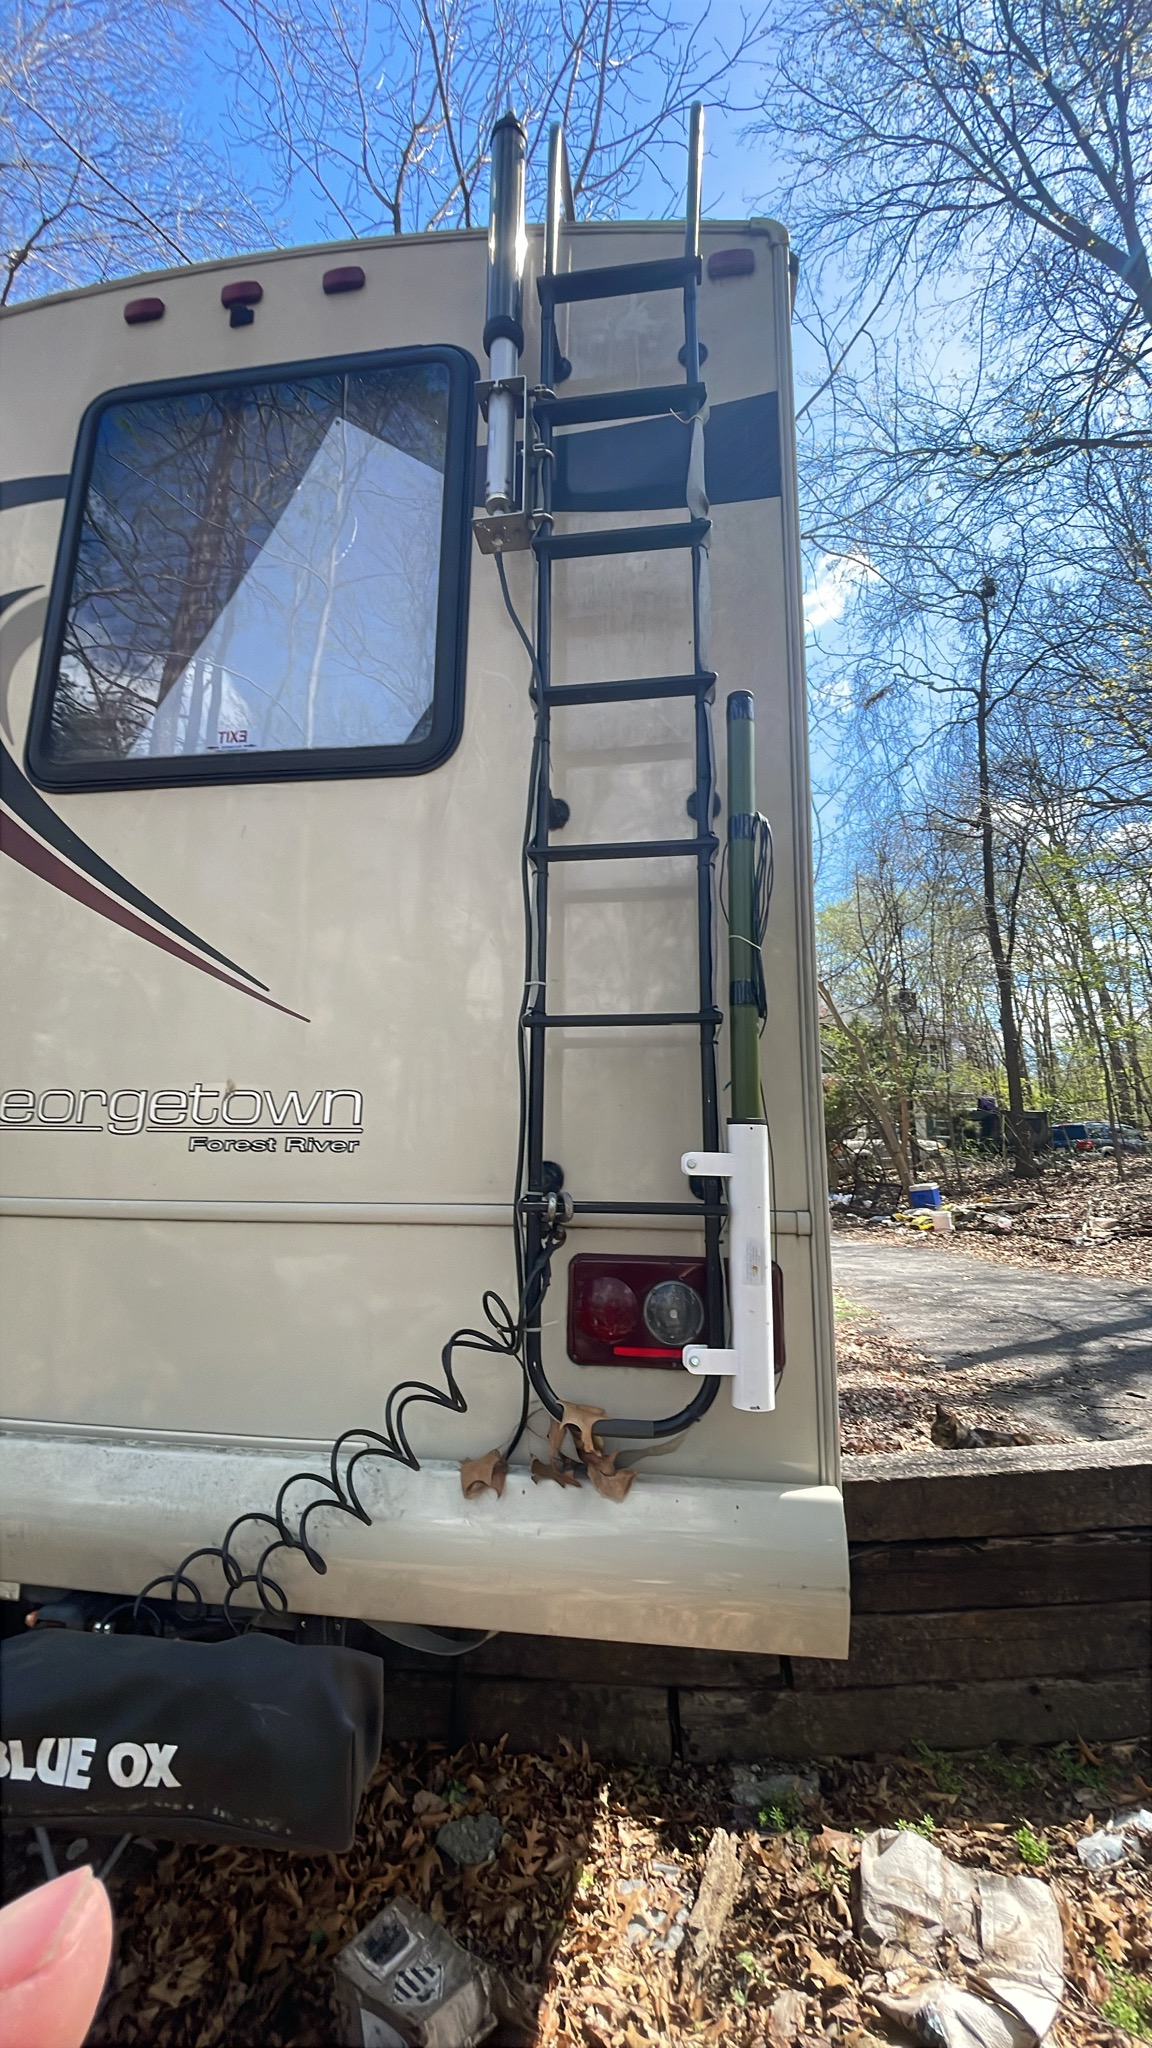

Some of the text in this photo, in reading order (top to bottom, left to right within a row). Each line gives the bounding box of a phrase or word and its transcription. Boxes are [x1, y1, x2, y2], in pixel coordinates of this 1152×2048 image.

[188, 1136, 360, 1153] Forest River
[107, 1742, 182, 1788] OX
